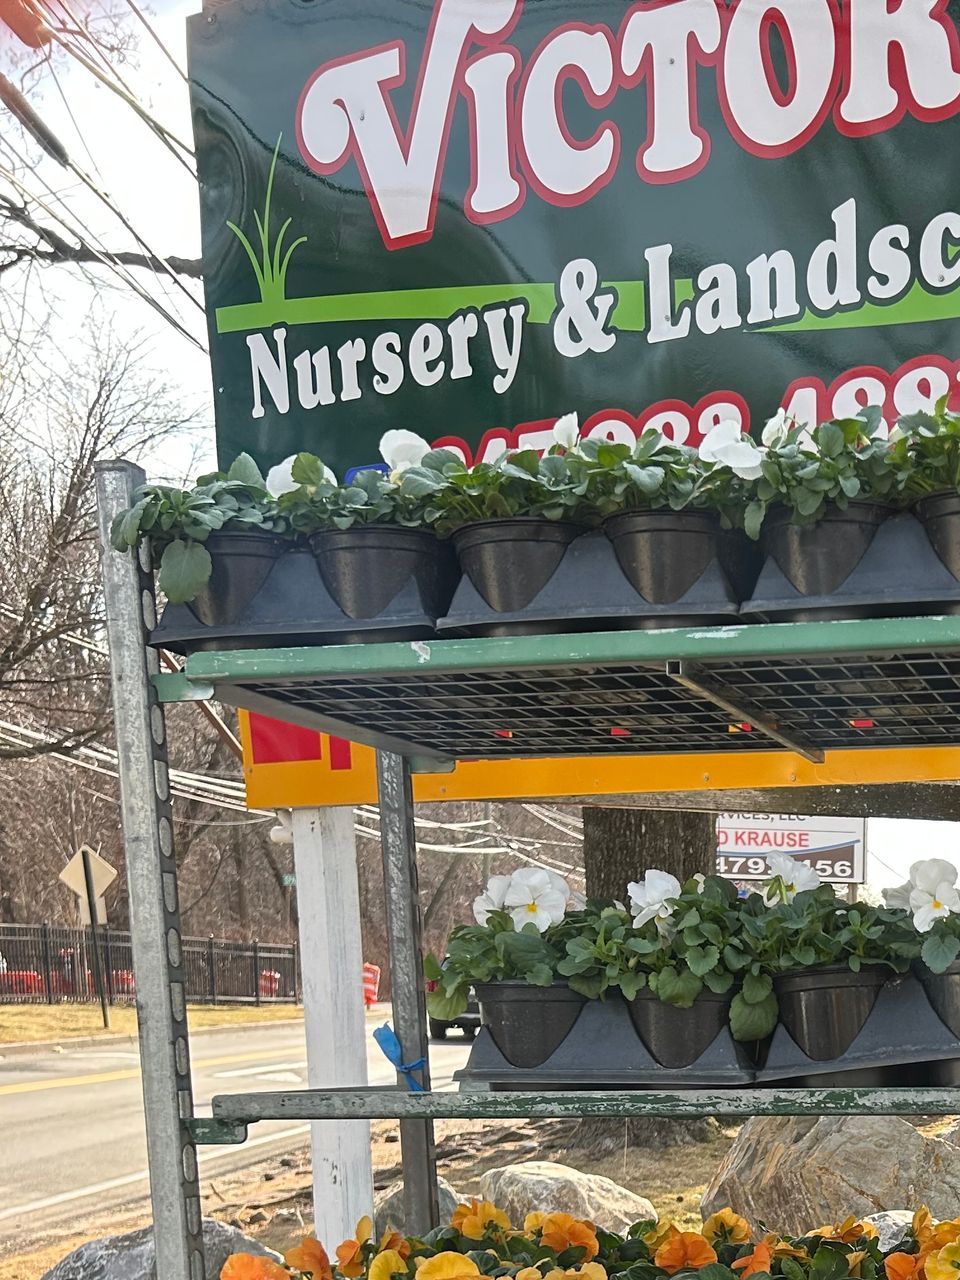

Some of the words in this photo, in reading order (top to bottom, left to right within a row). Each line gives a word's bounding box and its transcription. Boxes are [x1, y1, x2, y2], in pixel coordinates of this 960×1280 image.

[245, 302, 527, 420] Nursery
[553, 257, 616, 359] &
[735, 831, 809, 848] KRAUSE
